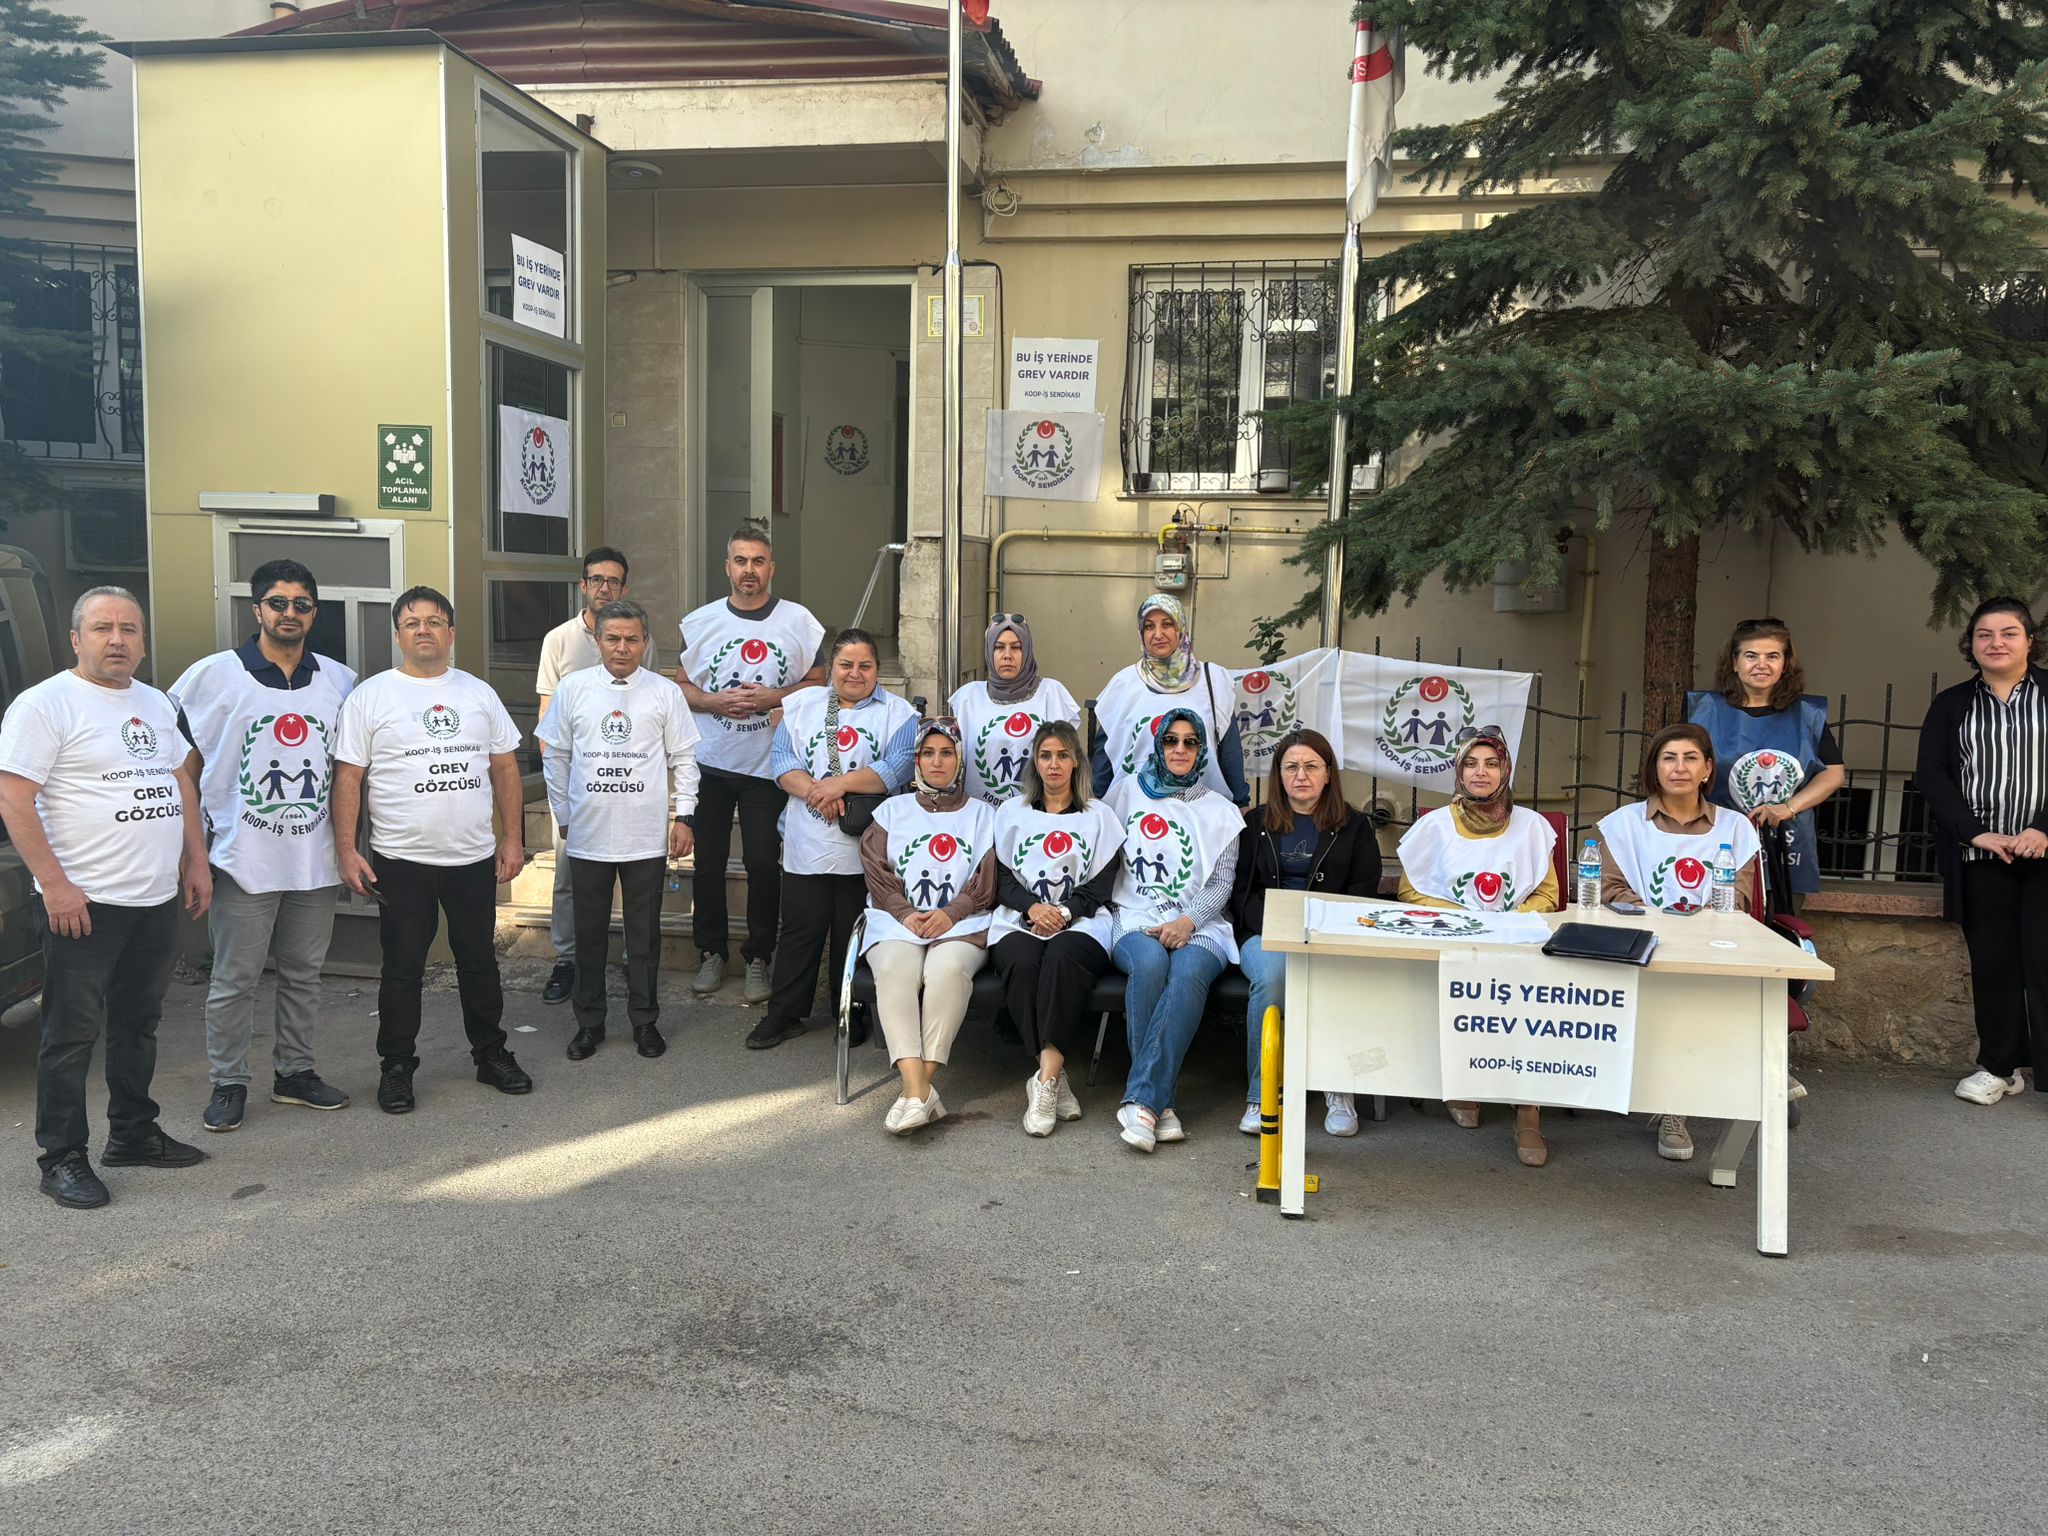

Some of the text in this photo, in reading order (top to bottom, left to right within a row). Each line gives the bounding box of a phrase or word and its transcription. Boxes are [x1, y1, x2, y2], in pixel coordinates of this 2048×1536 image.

[516, 254, 561, 282] BU İŞ YERİNDE
[518, 275, 560, 300] GREV VARDIR
[1016, 350, 1093, 364] BU İŞ YERİNDE
[1018, 369, 1089, 380] GREV VARDIR
[1024, 389, 1081, 399] KOOP-İŞ SENDİKASI
[1011, 464, 1075, 489] KOOP-İŞ SENDİKASI
[381, 486, 428, 495] TOPLANMA
[391, 496, 418, 504] ALANI
[404, 744, 481, 757] KOOP-İŞ SENDİKASI
[582, 751, 648, 759] KOOP-İŞ SENDİKASI
[1375, 736, 1412, 772] KOOP-İŞ
[102, 768, 145, 781] KOOP-İŞ
[428, 762, 469, 775] GREV
[597, 767, 633, 777] GREV
[414, 775, 481, 793] GÖZCÜSÜ
[586, 780, 645, 793] GÖZCÜSÜ
[133, 785, 173, 801] GREV
[241, 810, 284, 837] KOOP-İŞ
[1450, 978, 1626, 1008] BU İŞ YERİNDE
[1453, 1014, 1618, 1043] GREV VARDIR
[1469, 1056, 1597, 1078] KOOP-İŞ SENDİKASI
